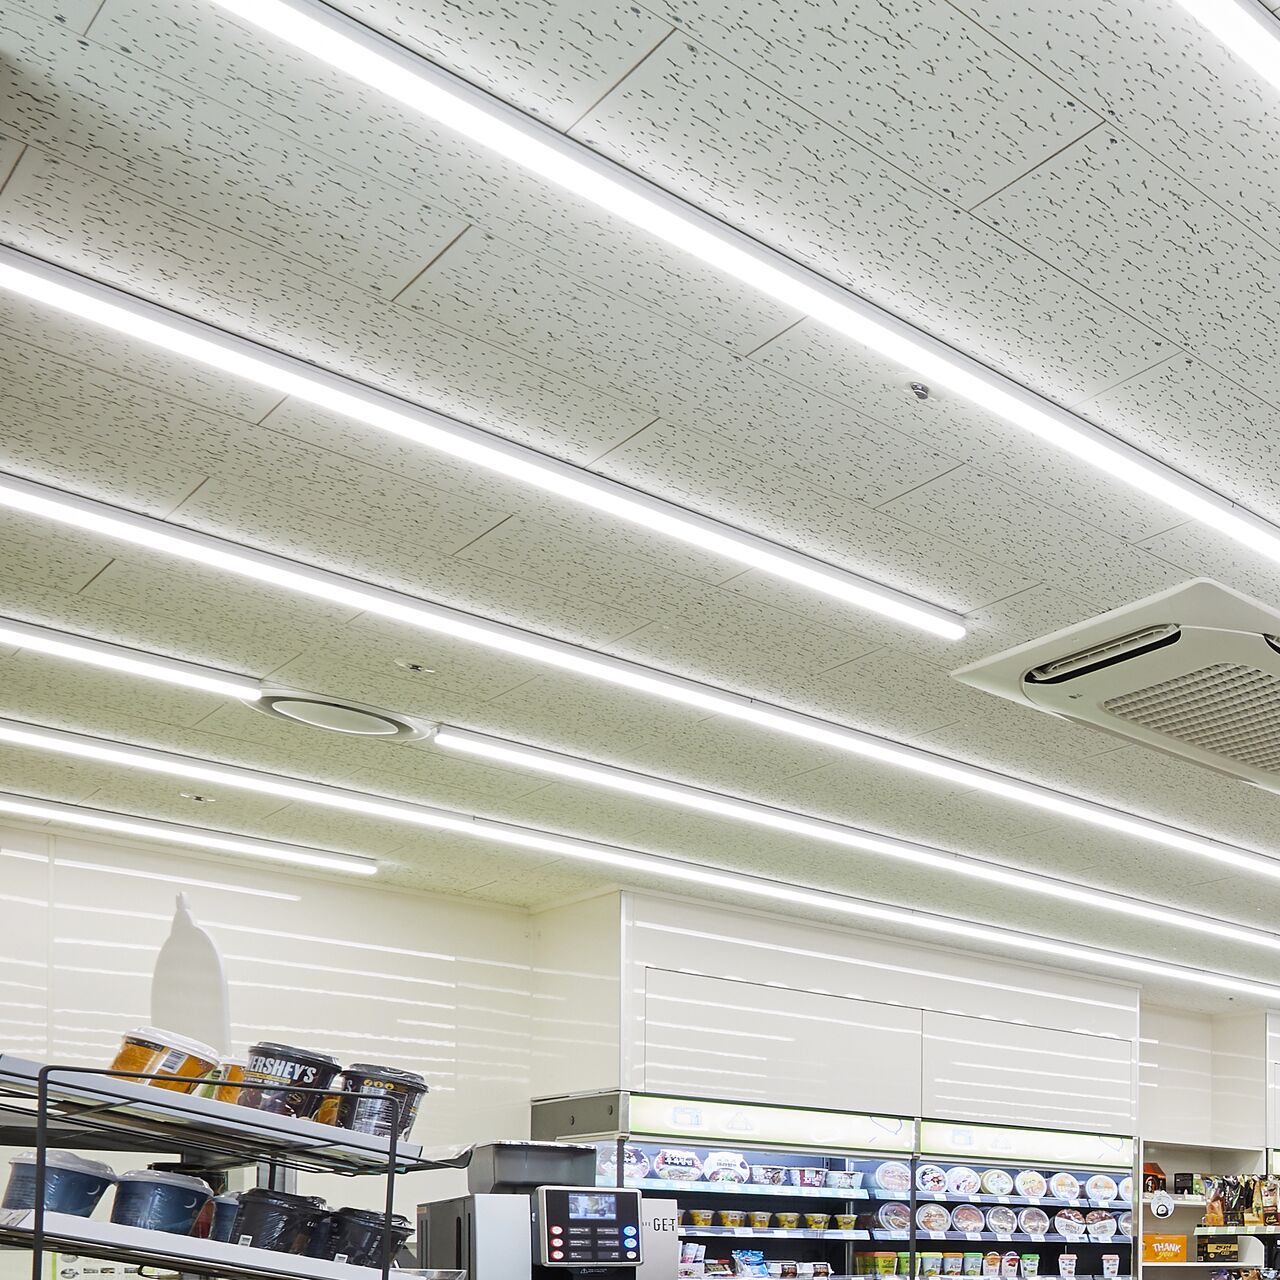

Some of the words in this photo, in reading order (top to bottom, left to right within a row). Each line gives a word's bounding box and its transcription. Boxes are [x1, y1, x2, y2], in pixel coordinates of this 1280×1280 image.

[250, 1055, 317, 1084] ERSHEY'S
[653, 1217, 676, 1232] GET
[1152, 1242, 1182, 1253] THANK
